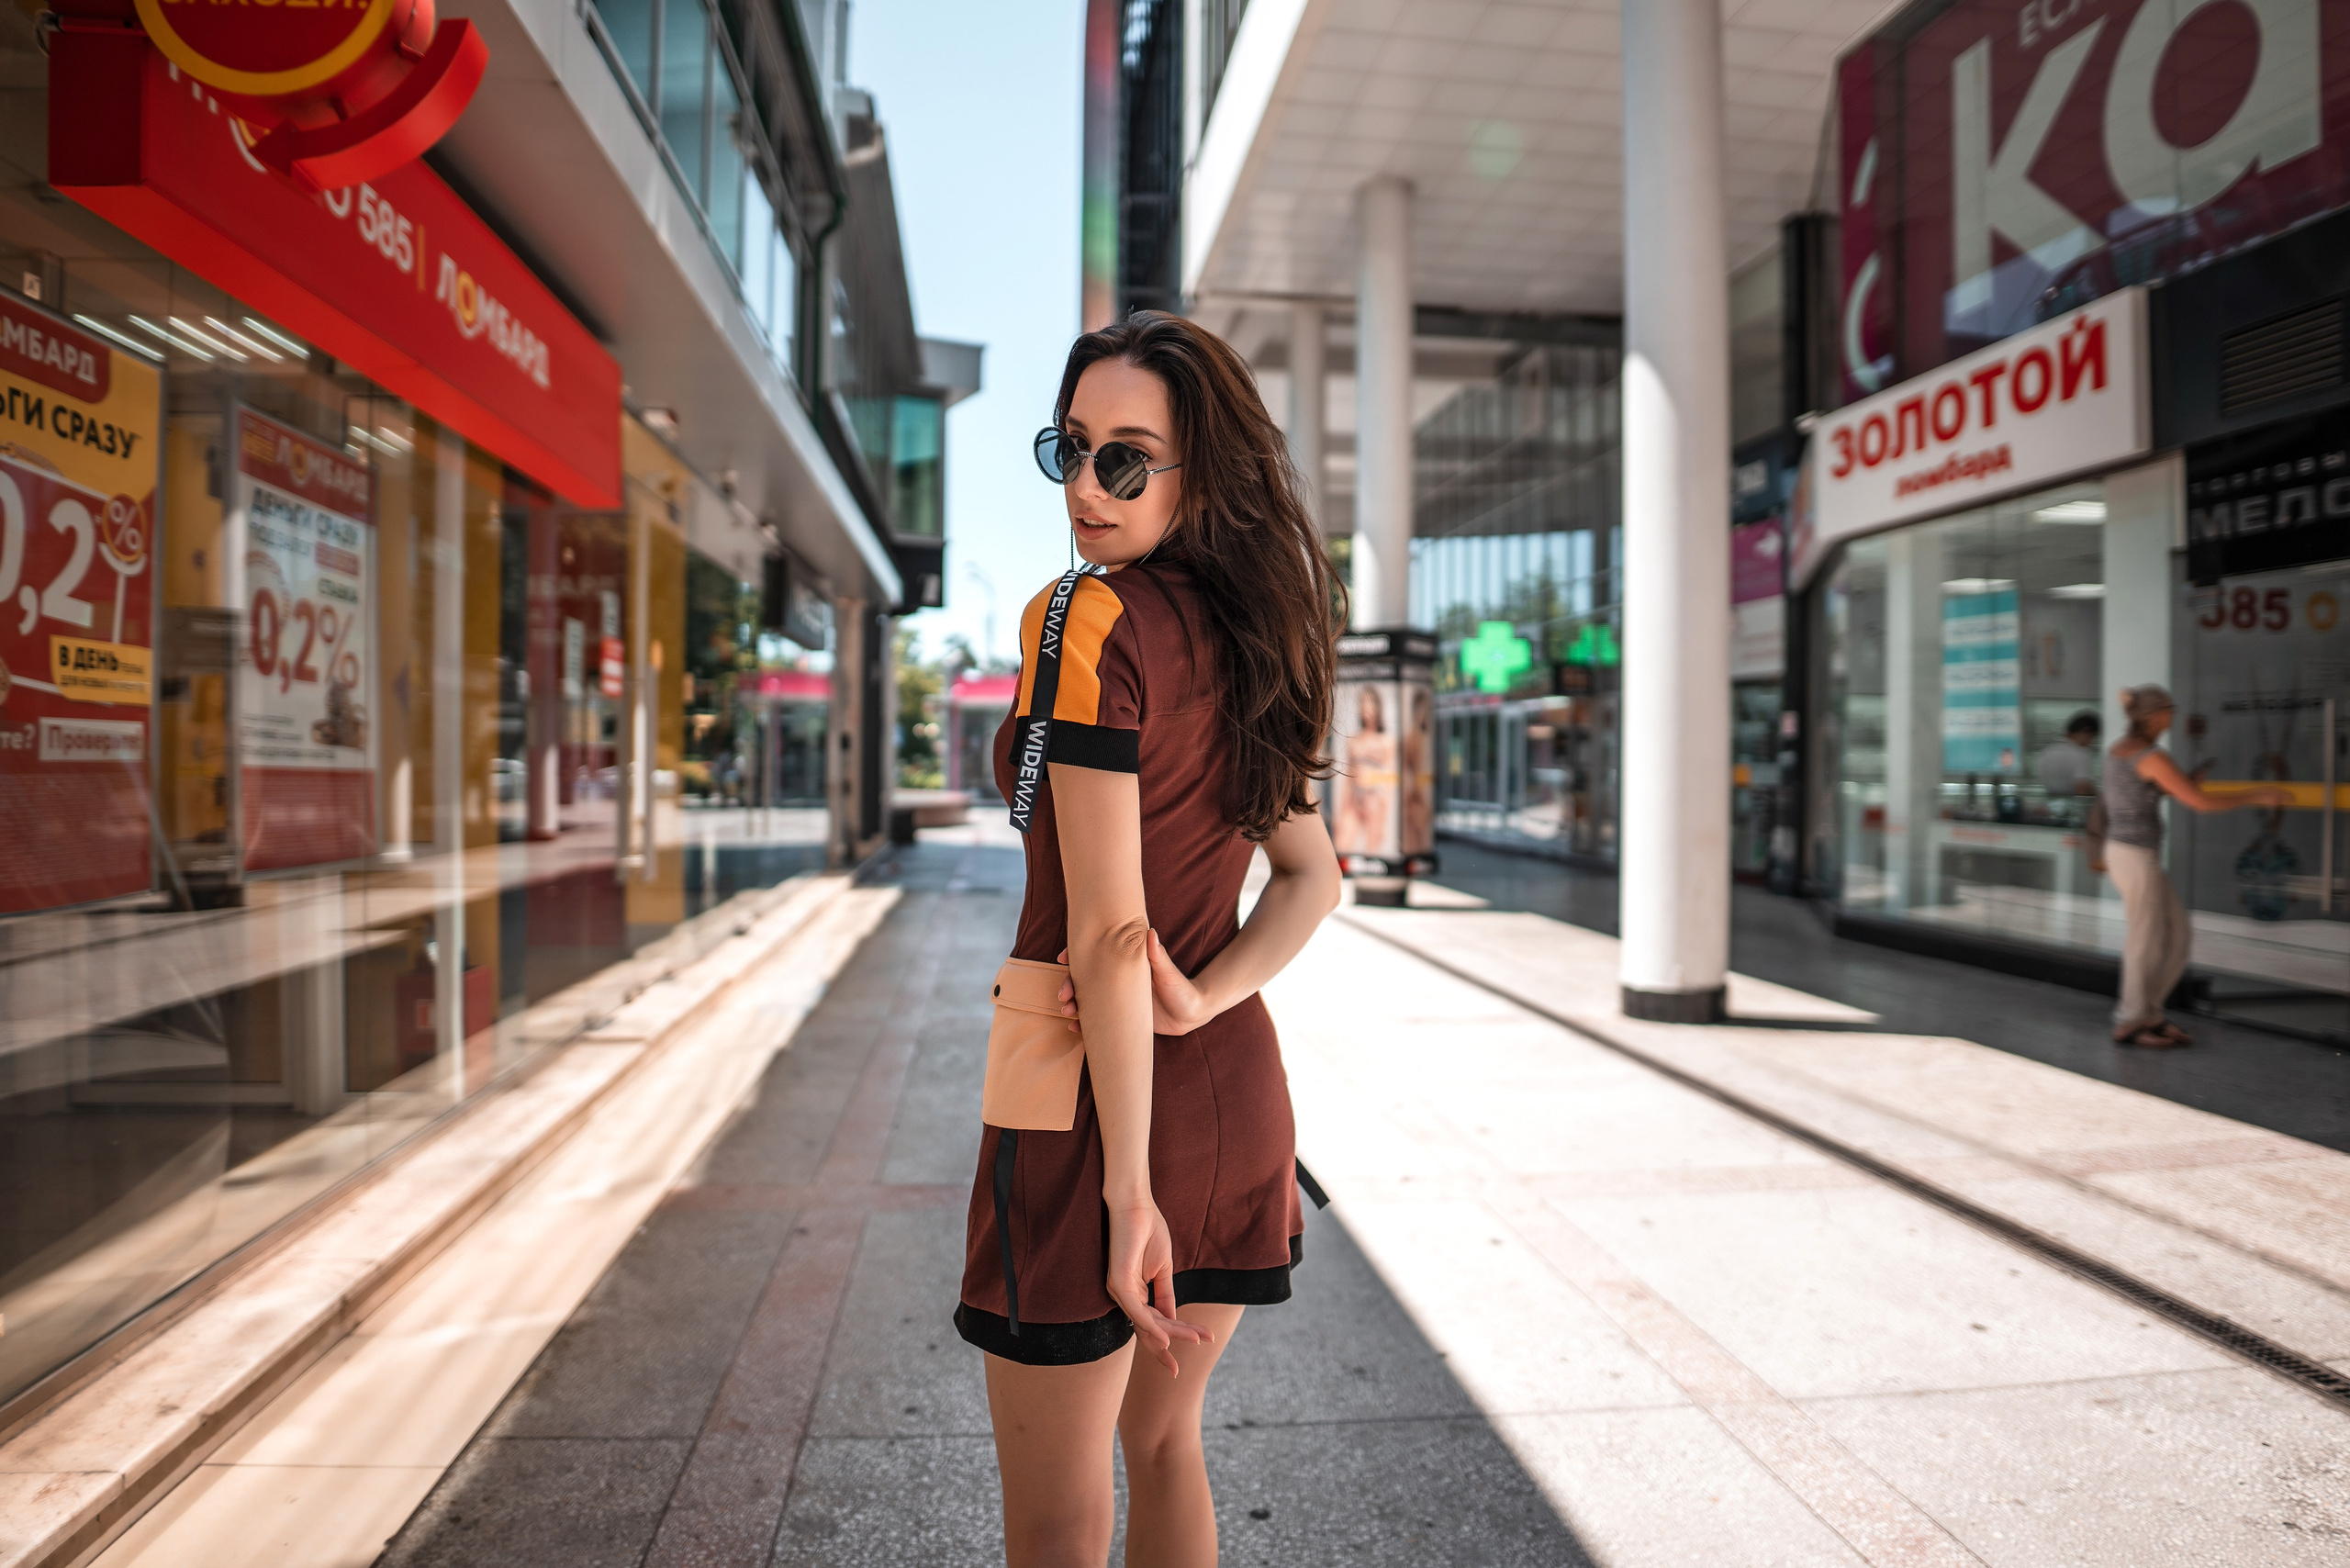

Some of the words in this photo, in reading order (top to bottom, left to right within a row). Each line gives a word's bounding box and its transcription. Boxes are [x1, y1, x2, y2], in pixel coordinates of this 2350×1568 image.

[358, 183, 414, 273] 585
[436, 252, 550, 389] ЛОМБАРД
[0, 316, 97, 385] МБАРД
[1830, 314, 2108, 478] ЗОЛОТОЙ
[51, 404, 138, 459] СРАЗУ
[1895, 442, 2012, 498] ломбард
[73, 646, 119, 671] ДЕНЬ
[1013, 721, 1047, 828] WIDEWAY
